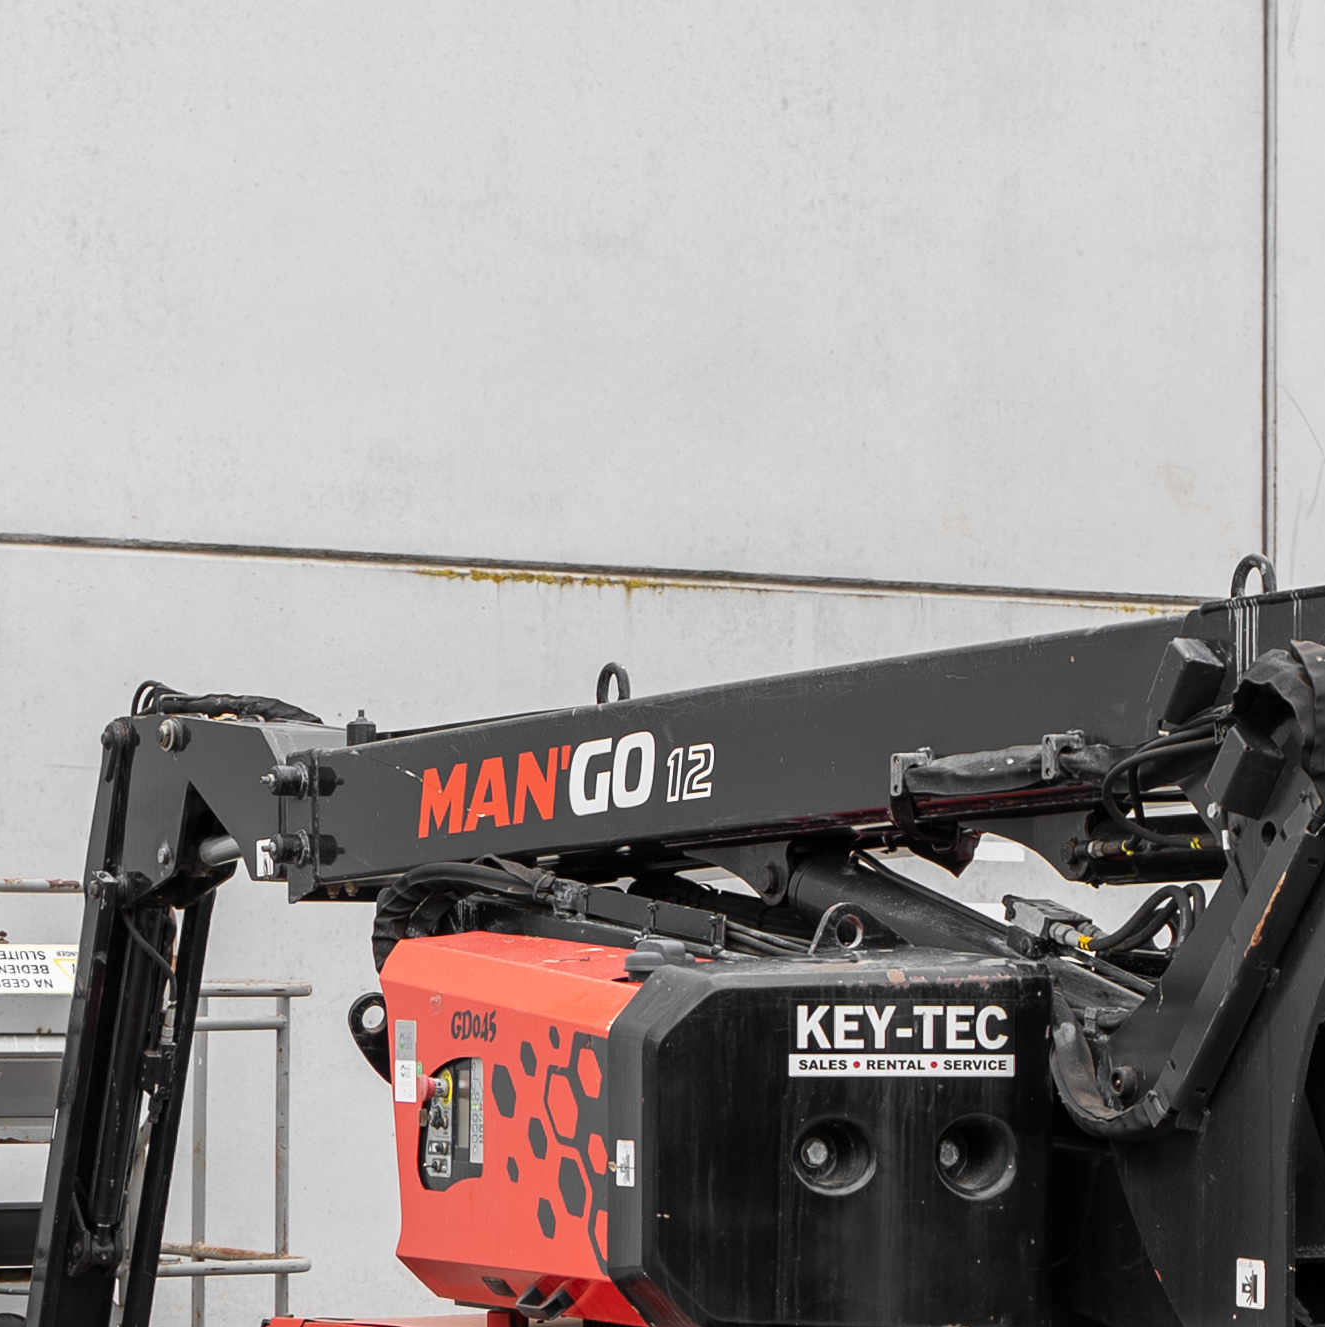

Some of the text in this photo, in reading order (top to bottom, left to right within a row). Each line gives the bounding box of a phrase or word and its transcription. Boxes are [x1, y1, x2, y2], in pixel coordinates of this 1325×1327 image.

[666, 743, 715, 803] 12
[33, 978, 54, 989] NA
[796, 1004, 1009, 1050] KEY-TEC
[798, 1058, 1008, 1071] SALES RENTAL SERVICE
